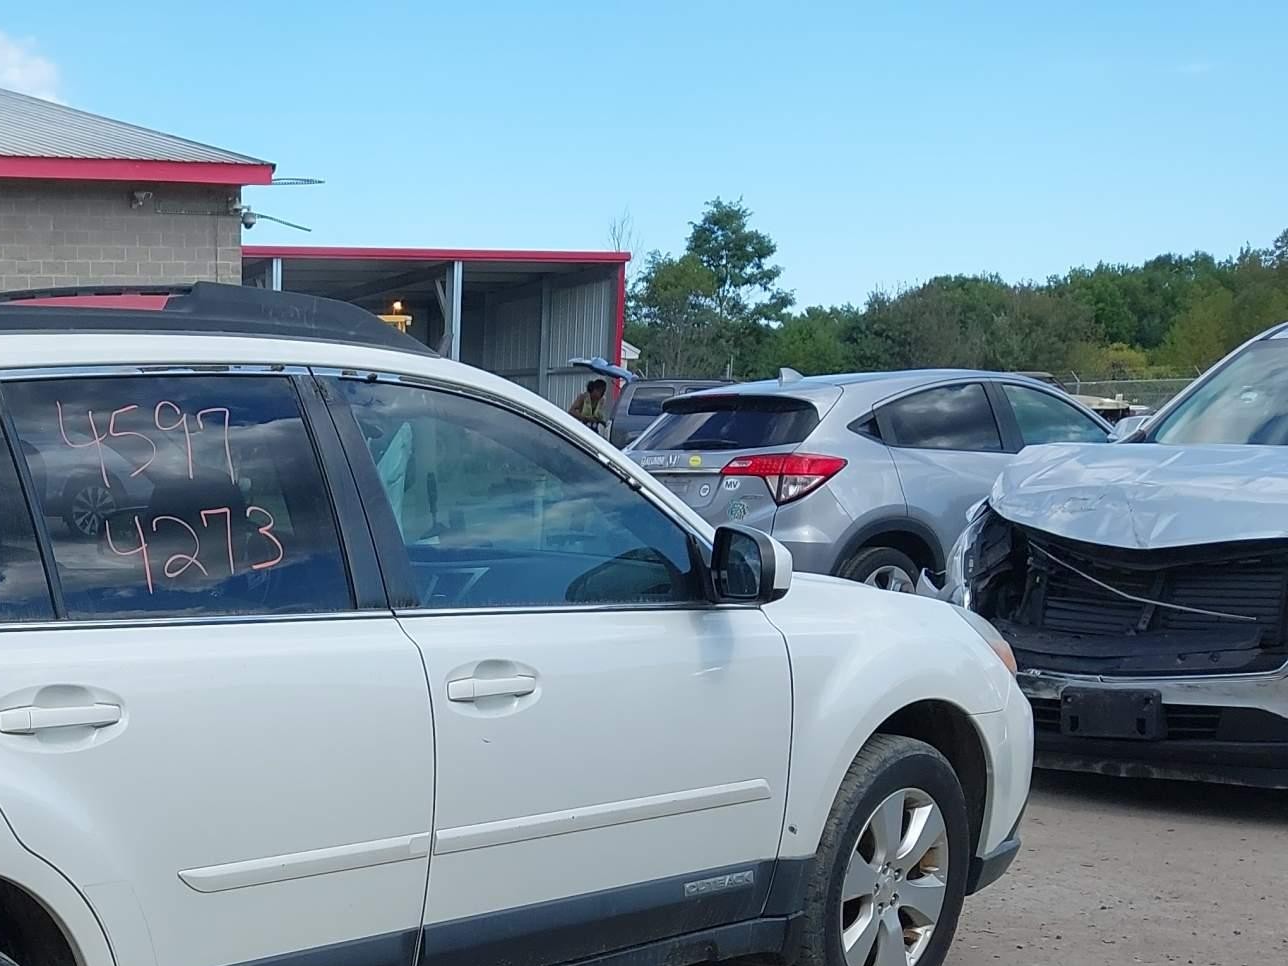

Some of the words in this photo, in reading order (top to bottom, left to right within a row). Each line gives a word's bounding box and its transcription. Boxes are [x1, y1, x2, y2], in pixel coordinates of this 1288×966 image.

[57, 401, 236, 487] 4597
[725, 481, 738, 489] MV
[106, 507, 283, 594] 4273
